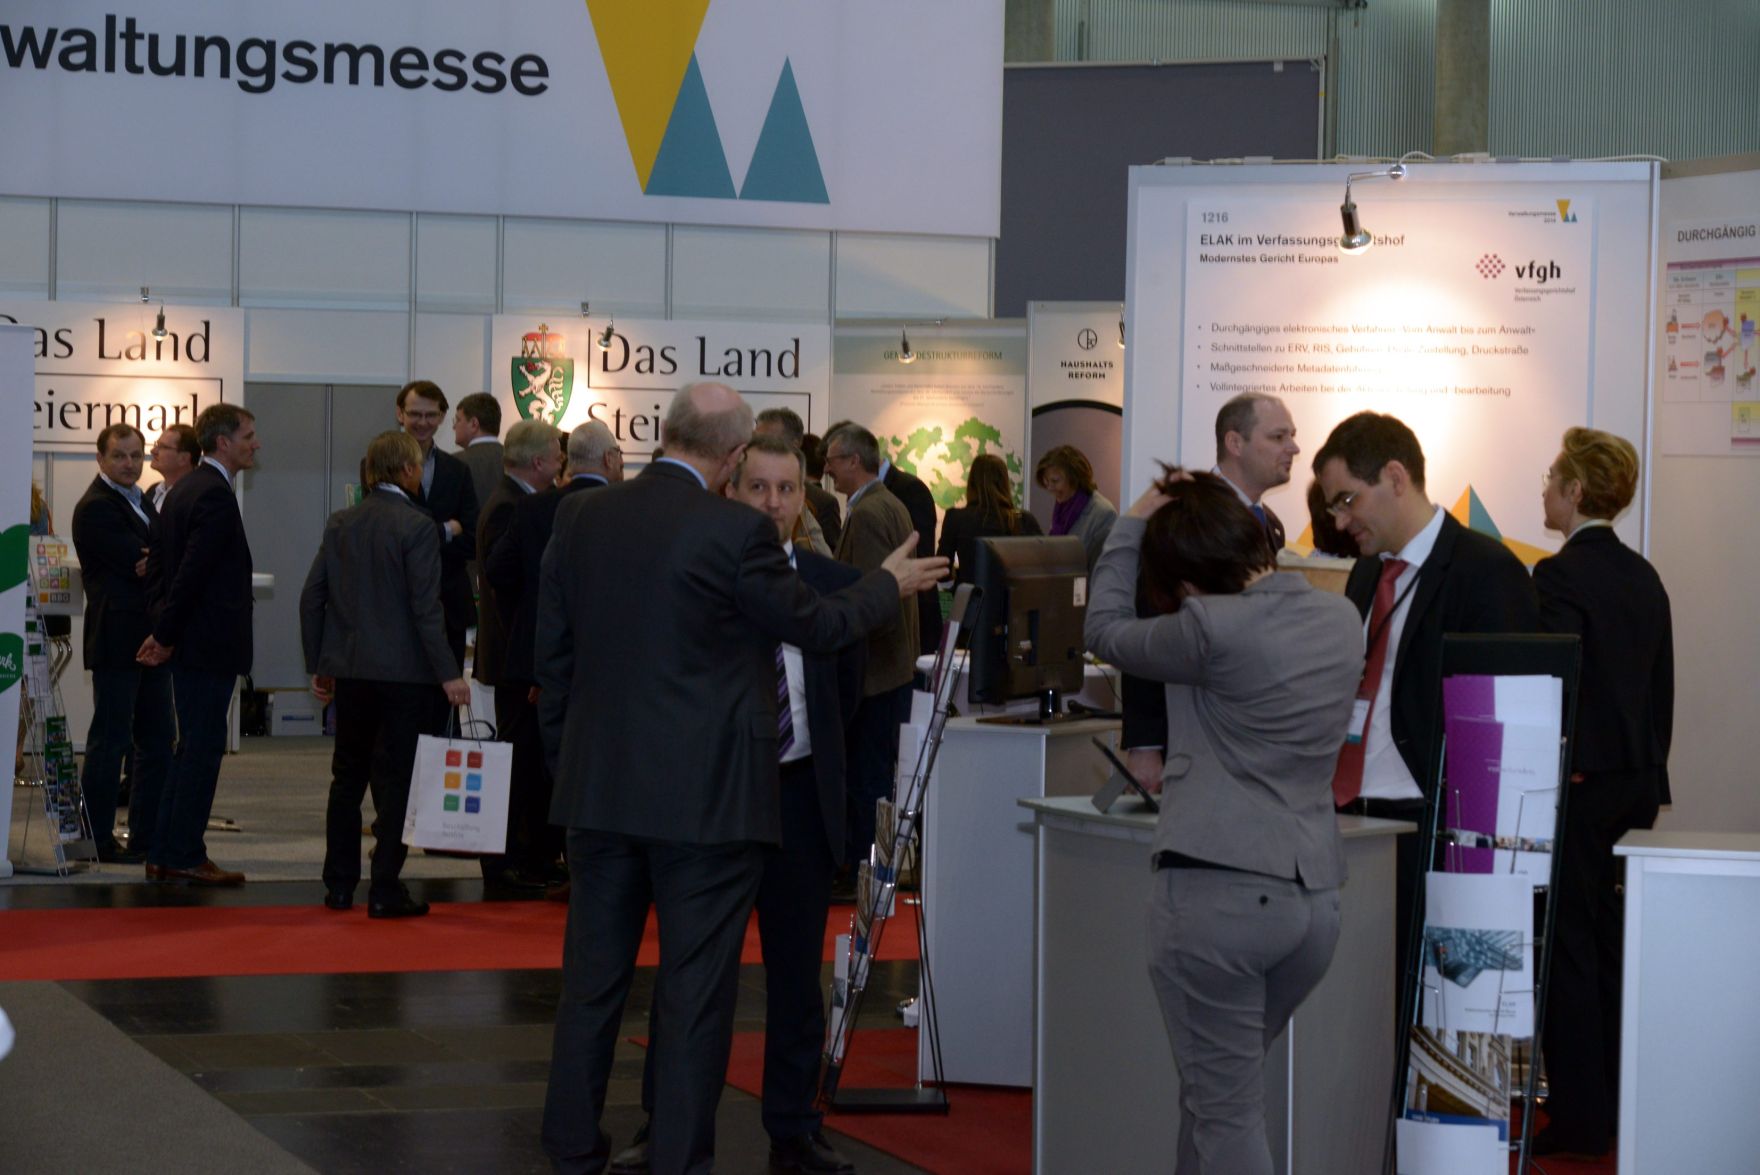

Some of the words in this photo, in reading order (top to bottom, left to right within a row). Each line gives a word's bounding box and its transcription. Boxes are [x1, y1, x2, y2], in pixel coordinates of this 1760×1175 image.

[0, 14, 549, 96] waltungsmesse
[1202, 212, 1228, 223] 1216
[1677, 224, 1756, 242] DURCHGÄNGIG
[1200, 234, 1234, 246] ELAK
[1238, 234, 1252, 246] im
[1257, 234, 1405, 248] Verfassungsgtshof
[1200, 253, 1257, 263] Modernstes
[1260, 253, 1295, 263] Gericht
[1298, 253, 1339, 265] Europas
[1515, 260, 1561, 284] vfgh
[1211, 322, 1281, 335] Durchgängiges
[1283, 323, 1349, 334] elektronisches
[1426, 325, 1458, 335] Anwalt
[1460, 325, 1475, 335] bis
[1477, 327, 1496, 335] zum
[0, 314, 73, 358] as
[94, 318, 210, 363] Land
[600, 331, 678, 375] Das
[695, 336, 800, 379] Land
[1211, 342, 1272, 353] Schnittstellen
[1275, 345, 1285, 353] zu
[1471, 344, 1529, 356] Druckstraße
[1061, 361, 1113, 369] HAUSHALTS
[1210, 361, 1295, 375] Maßgeschneiderte
[1068, 371, 1105, 379] REFORM
[1210, 382, 1277, 394] Vollintegriertes
[1279, 383, 1318, 393] Arbeiten
[1320, 383, 1334, 394] bei
